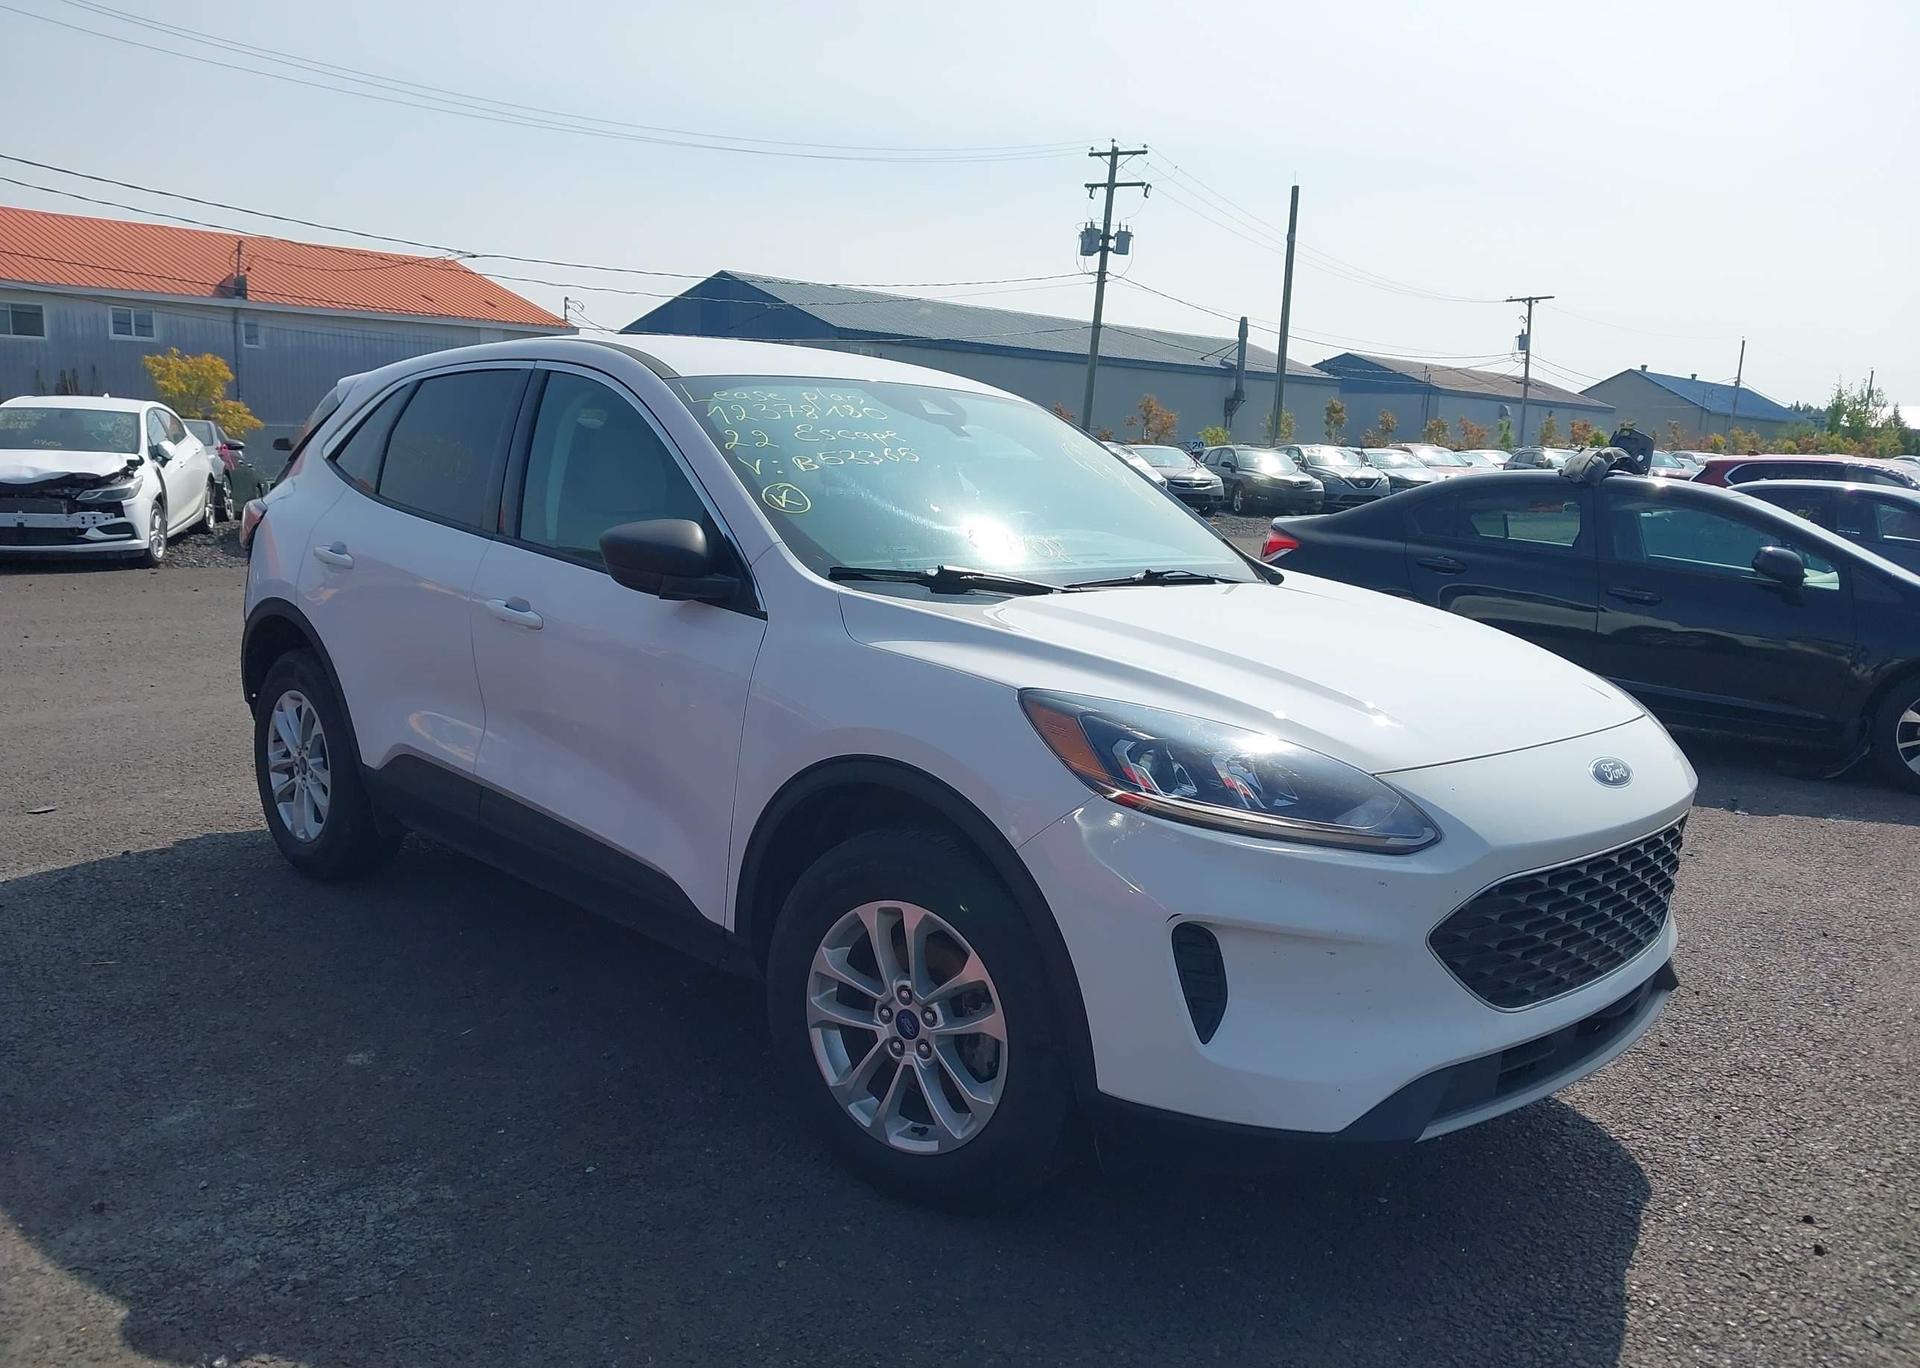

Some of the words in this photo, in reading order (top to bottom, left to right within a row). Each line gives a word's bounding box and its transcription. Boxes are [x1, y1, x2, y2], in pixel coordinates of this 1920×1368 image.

[724, 429, 780, 450] 22
[794, 424, 907, 448] Escape
[1192, 441, 1205, 450] 20
[1600, 762, 1628, 781] Ford
